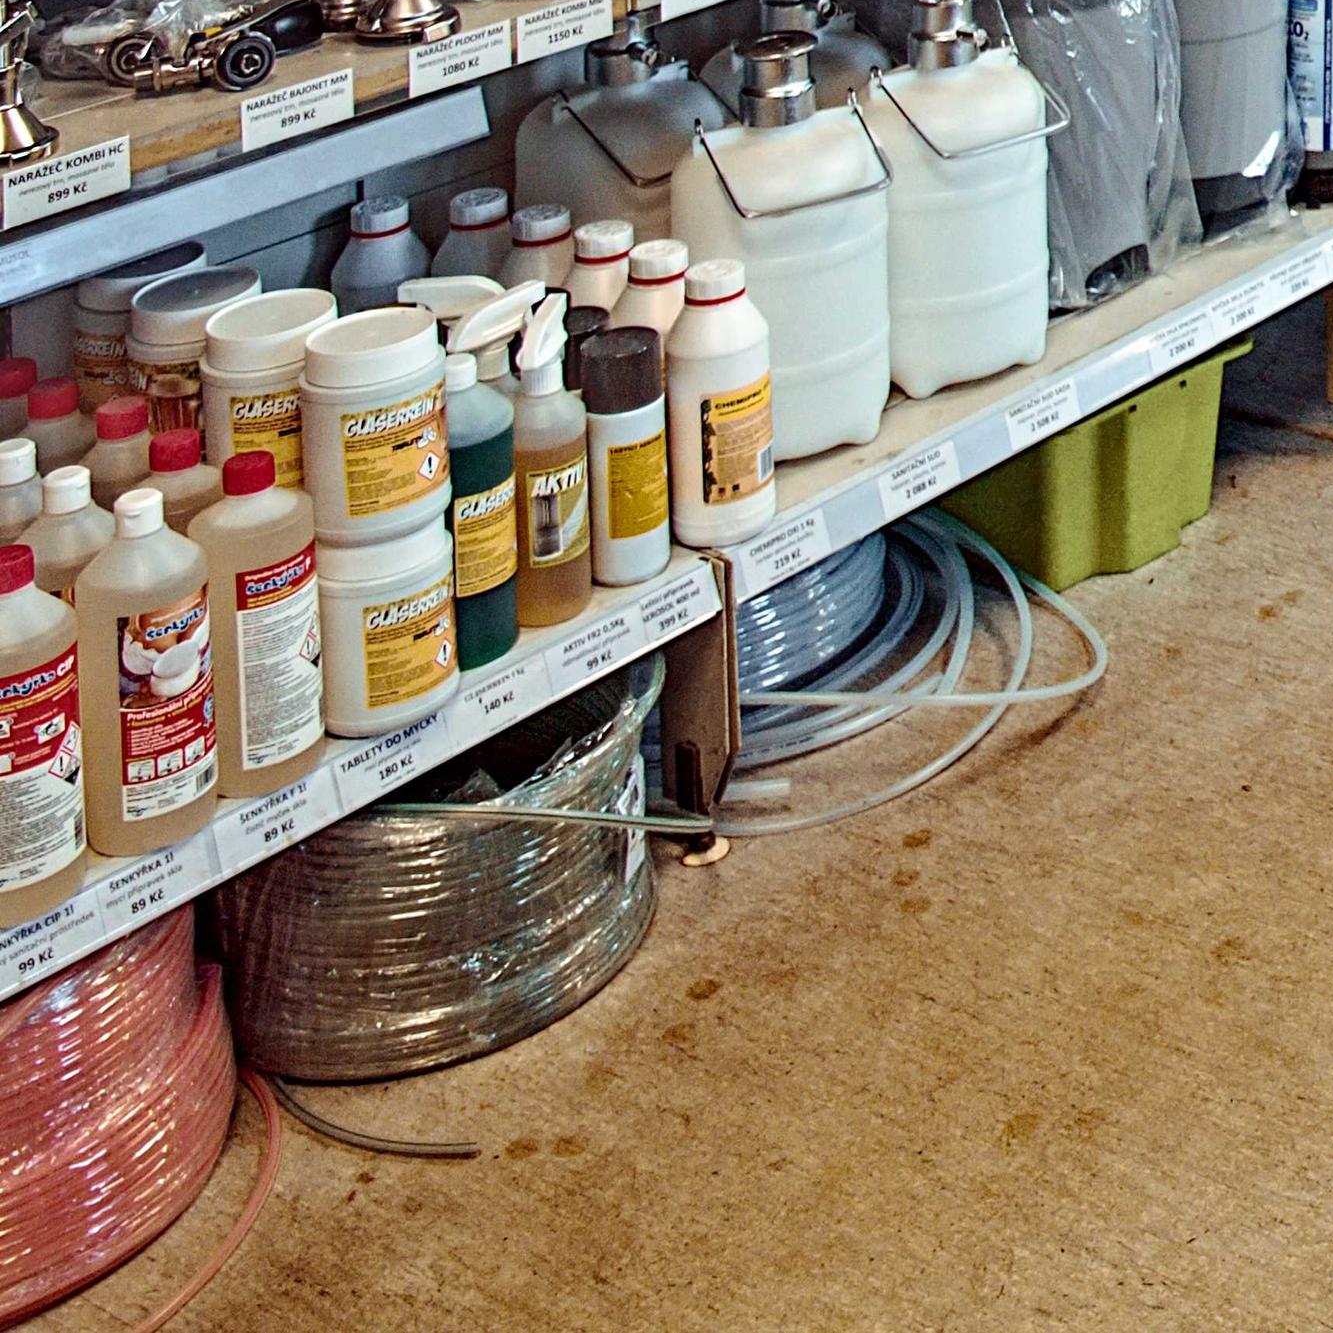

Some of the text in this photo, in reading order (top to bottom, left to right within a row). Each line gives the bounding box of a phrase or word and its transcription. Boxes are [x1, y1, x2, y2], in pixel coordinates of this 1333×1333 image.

[416, 24, 505, 60] NARÁŽEČ PLOCHÝ MM
[548, 23, 584, 45] 1150 Kč
[442, 57, 481, 77] 1080 Kč
[246, 74, 350, 112] NARÁŽEČ BAJONET MM
[281, 108, 317, 129] 899 Kč
[8, 141, 126, 189] NARÁŽEČ KOMBI HC
[47, 181, 89, 203] 899 Kč
[587, 650, 612, 671] 99 Kč
[484, 691, 514, 714] 140 Kč
[341, 713, 439, 775] TABLETY DO MYČKY
[379, 753, 414, 781] 180 Kč
[264, 818, 295, 843] 89 Kč
[108, 858, 163, 893] ŠENKÝŘKA
[131, 887, 164, 915] 89 Kč
[18, 946, 55, 973] 99 Kč
